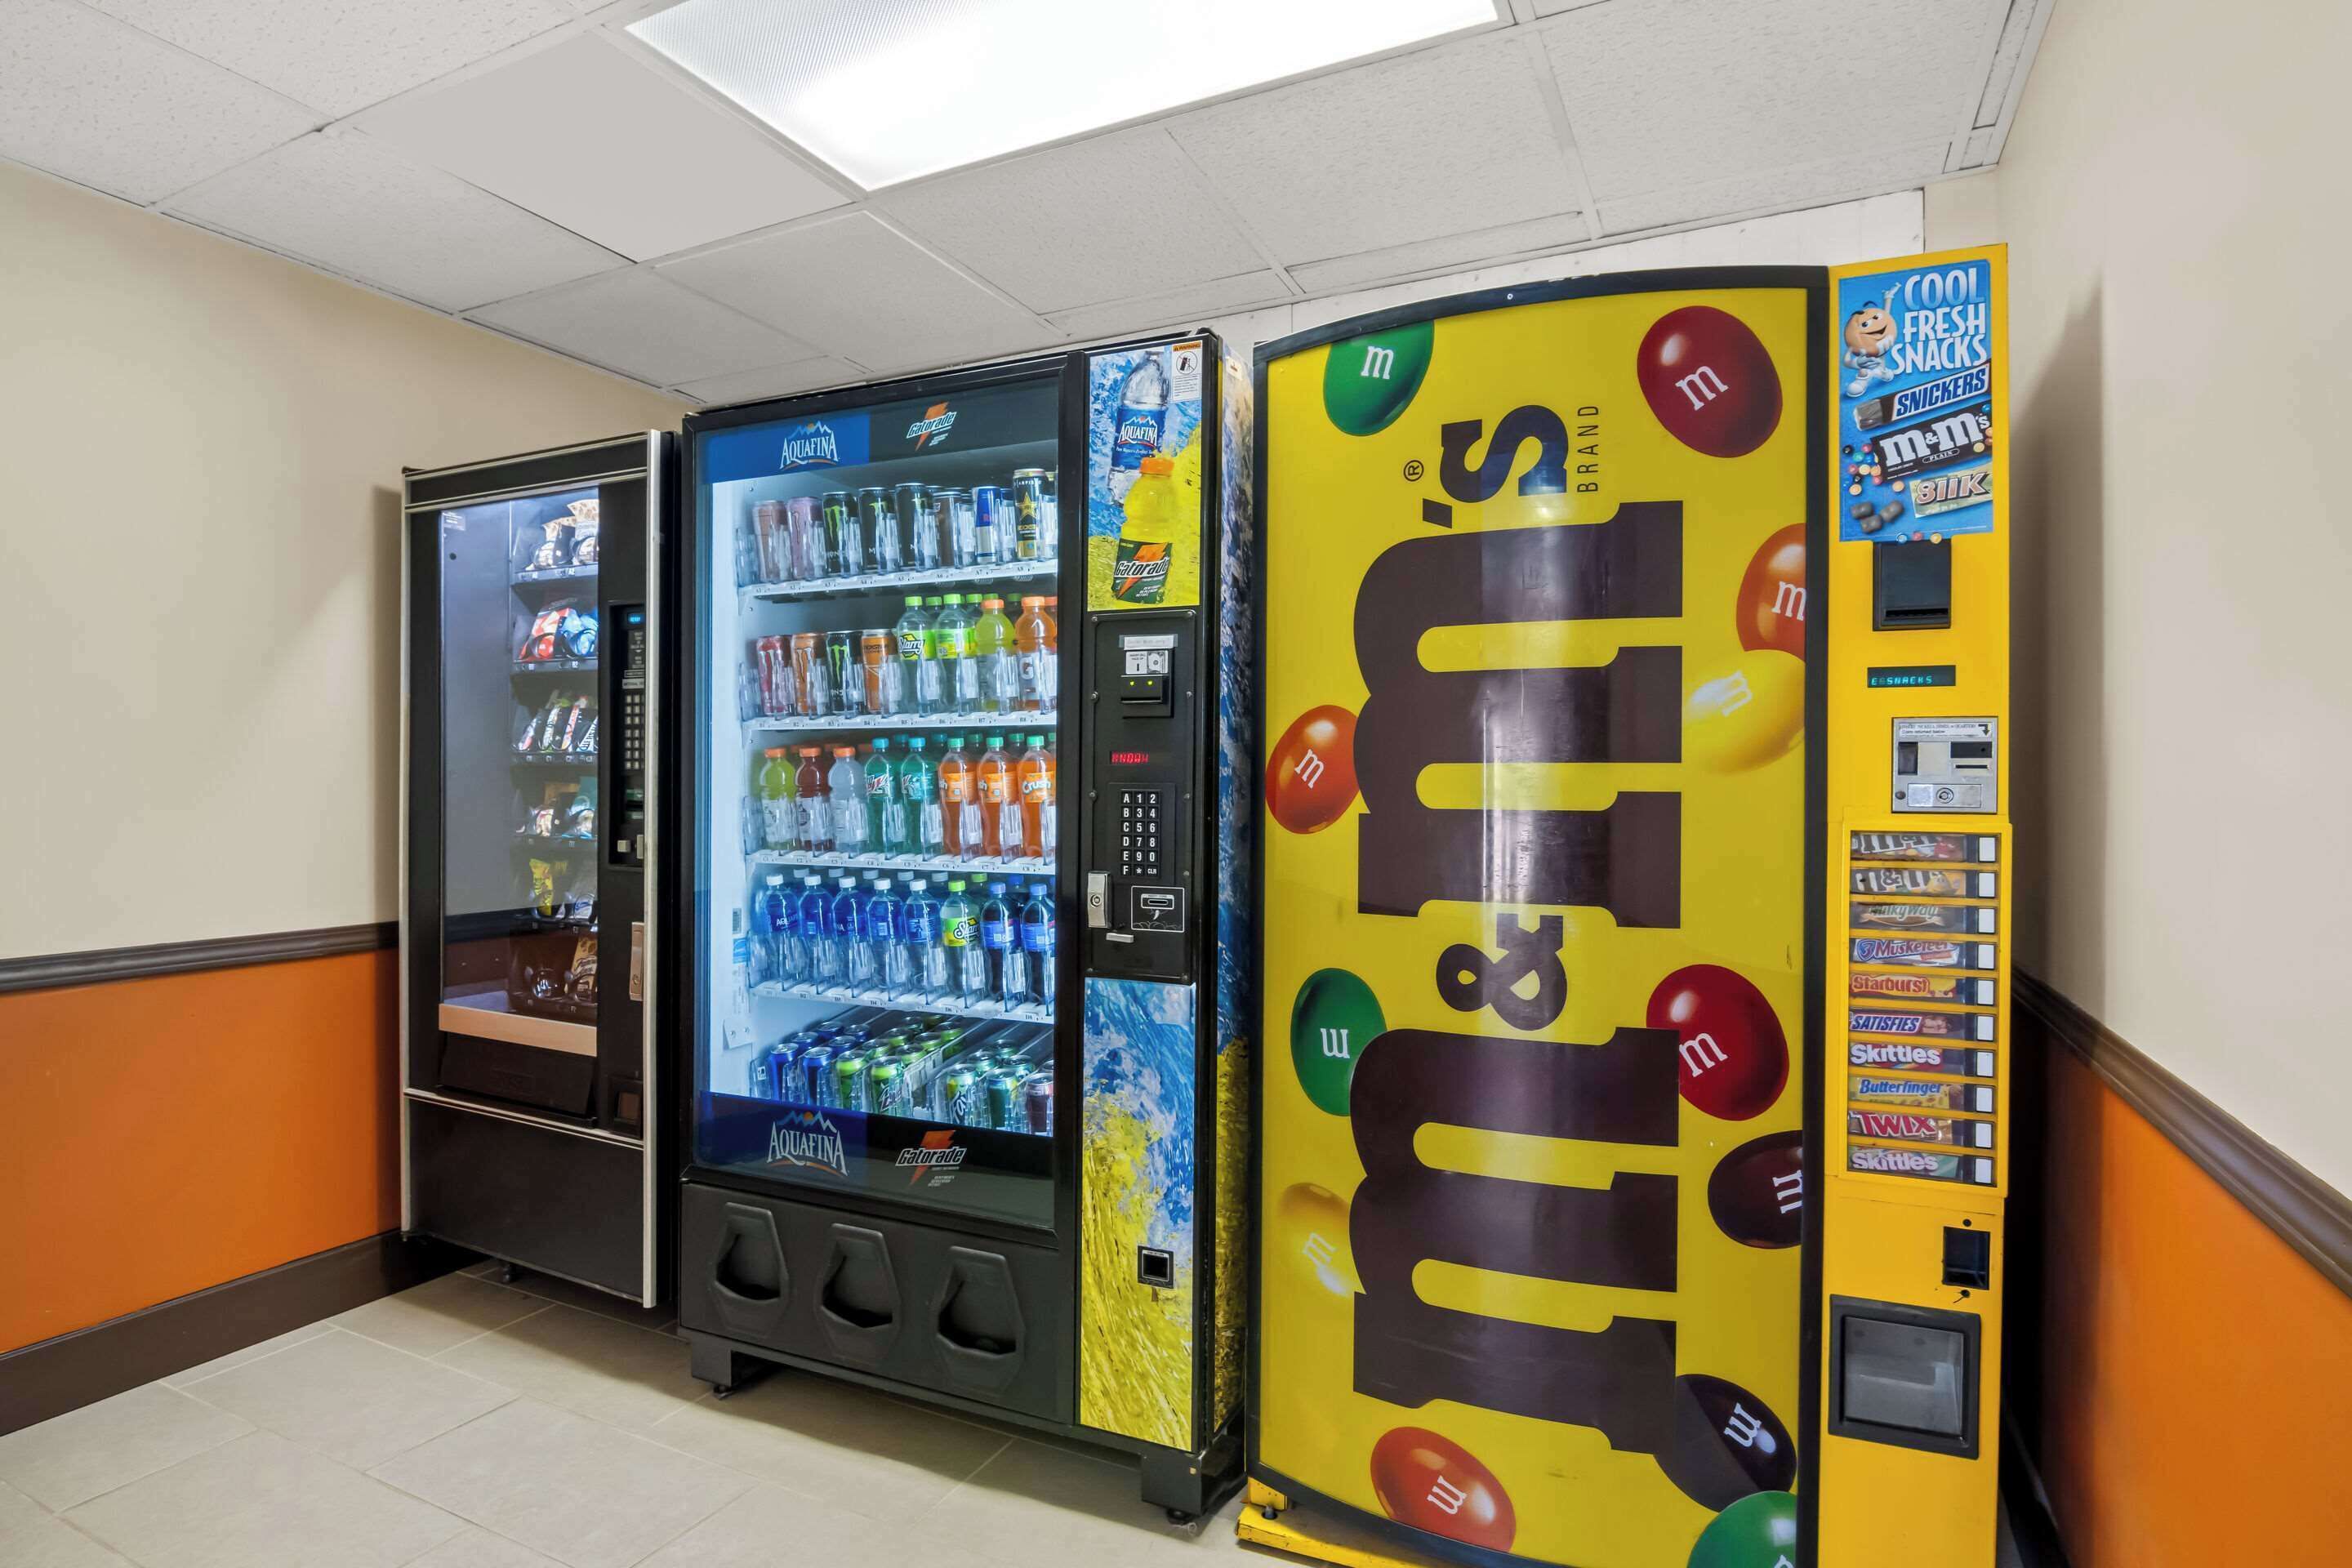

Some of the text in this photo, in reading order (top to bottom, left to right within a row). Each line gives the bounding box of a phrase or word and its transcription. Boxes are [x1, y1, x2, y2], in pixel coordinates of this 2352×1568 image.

[1904, 267, 1985, 312] COOL
[1903, 303, 1986, 342] FRESH
[1362, 345, 1395, 380] m
[1891, 333, 1988, 375] SNACKS
[1676, 364, 1729, 411] m
[1896, 369, 1986, 418] SNICKERS
[906, 411, 958, 439] Gatorade
[1117, 421, 1158, 447] AQUAFINA
[779, 430, 840, 471] AQUAFINA
[1577, 405, 1600, 493] BRAND
[1929, 451, 1953, 461] PLAIN
[1294, 748, 1325, 789] m
[1022, 779, 1051, 794] Crush
[1123, 794, 1156, 804] A 1 2
[1123, 808, 1156, 817] B 3 4
[1123, 822, 1156, 832] C 5 6
[1123, 837, 1156, 847] D 7 8
[1123, 851, 1156, 862] E 9 0
[1123, 865, 1129, 875] F
[1851, 976, 1929, 993] Starburst
[1851, 1016, 1920, 1032] SATISFIES
[1679, 1031, 1728, 1078] m
[1850, 1044, 1941, 1066] Skittles
[1859, 1079, 1941, 1096] Butterfinger
[1856, 1112, 1937, 1137] TWIX
[766, 1120, 850, 1177] AQUAFINA
[895, 1146, 968, 1167] Gatorade
[1851, 1152, 1939, 1171] Skittles
